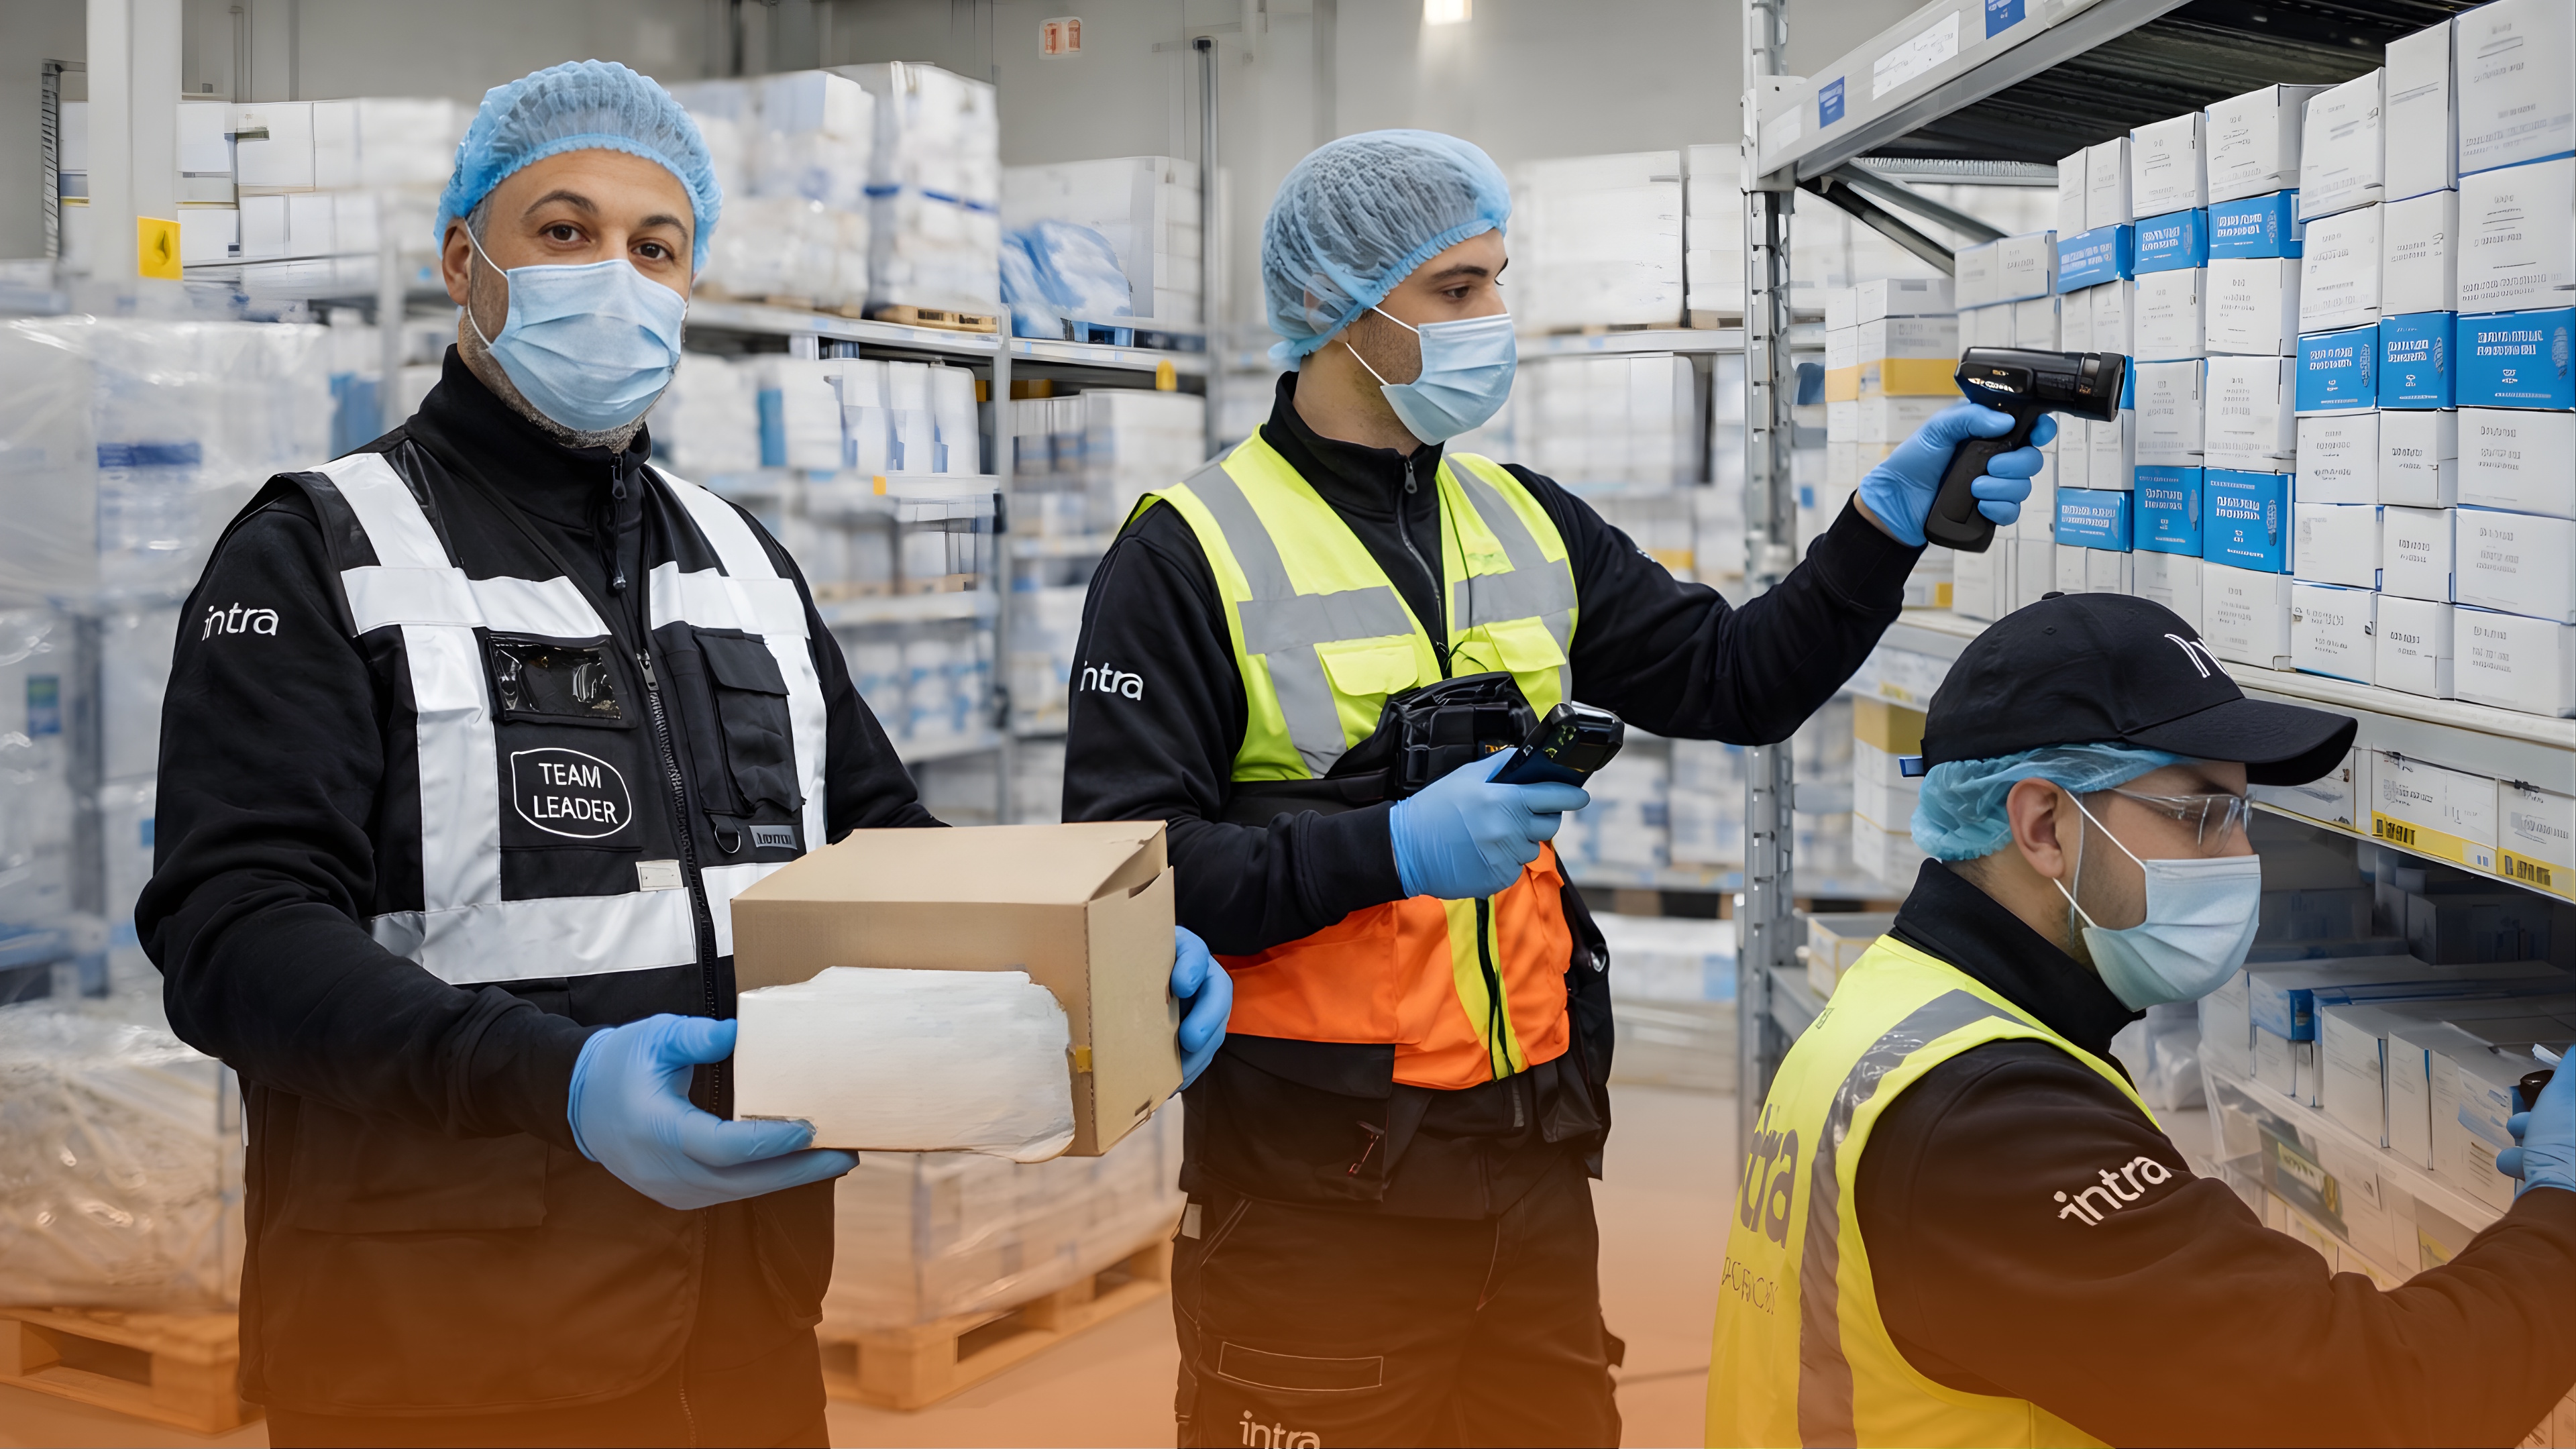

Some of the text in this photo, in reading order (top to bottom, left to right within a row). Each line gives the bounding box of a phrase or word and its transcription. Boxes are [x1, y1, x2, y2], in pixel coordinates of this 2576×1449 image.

[202, 602, 279, 641] intra
[538, 763, 601, 789] TEAM
[533, 796, 619, 824] LEADER
[1740, 1103, 1799, 1250] tra
[2053, 1156, 2173, 1226] intra
[1239, 1409, 1321, 1449] intra
